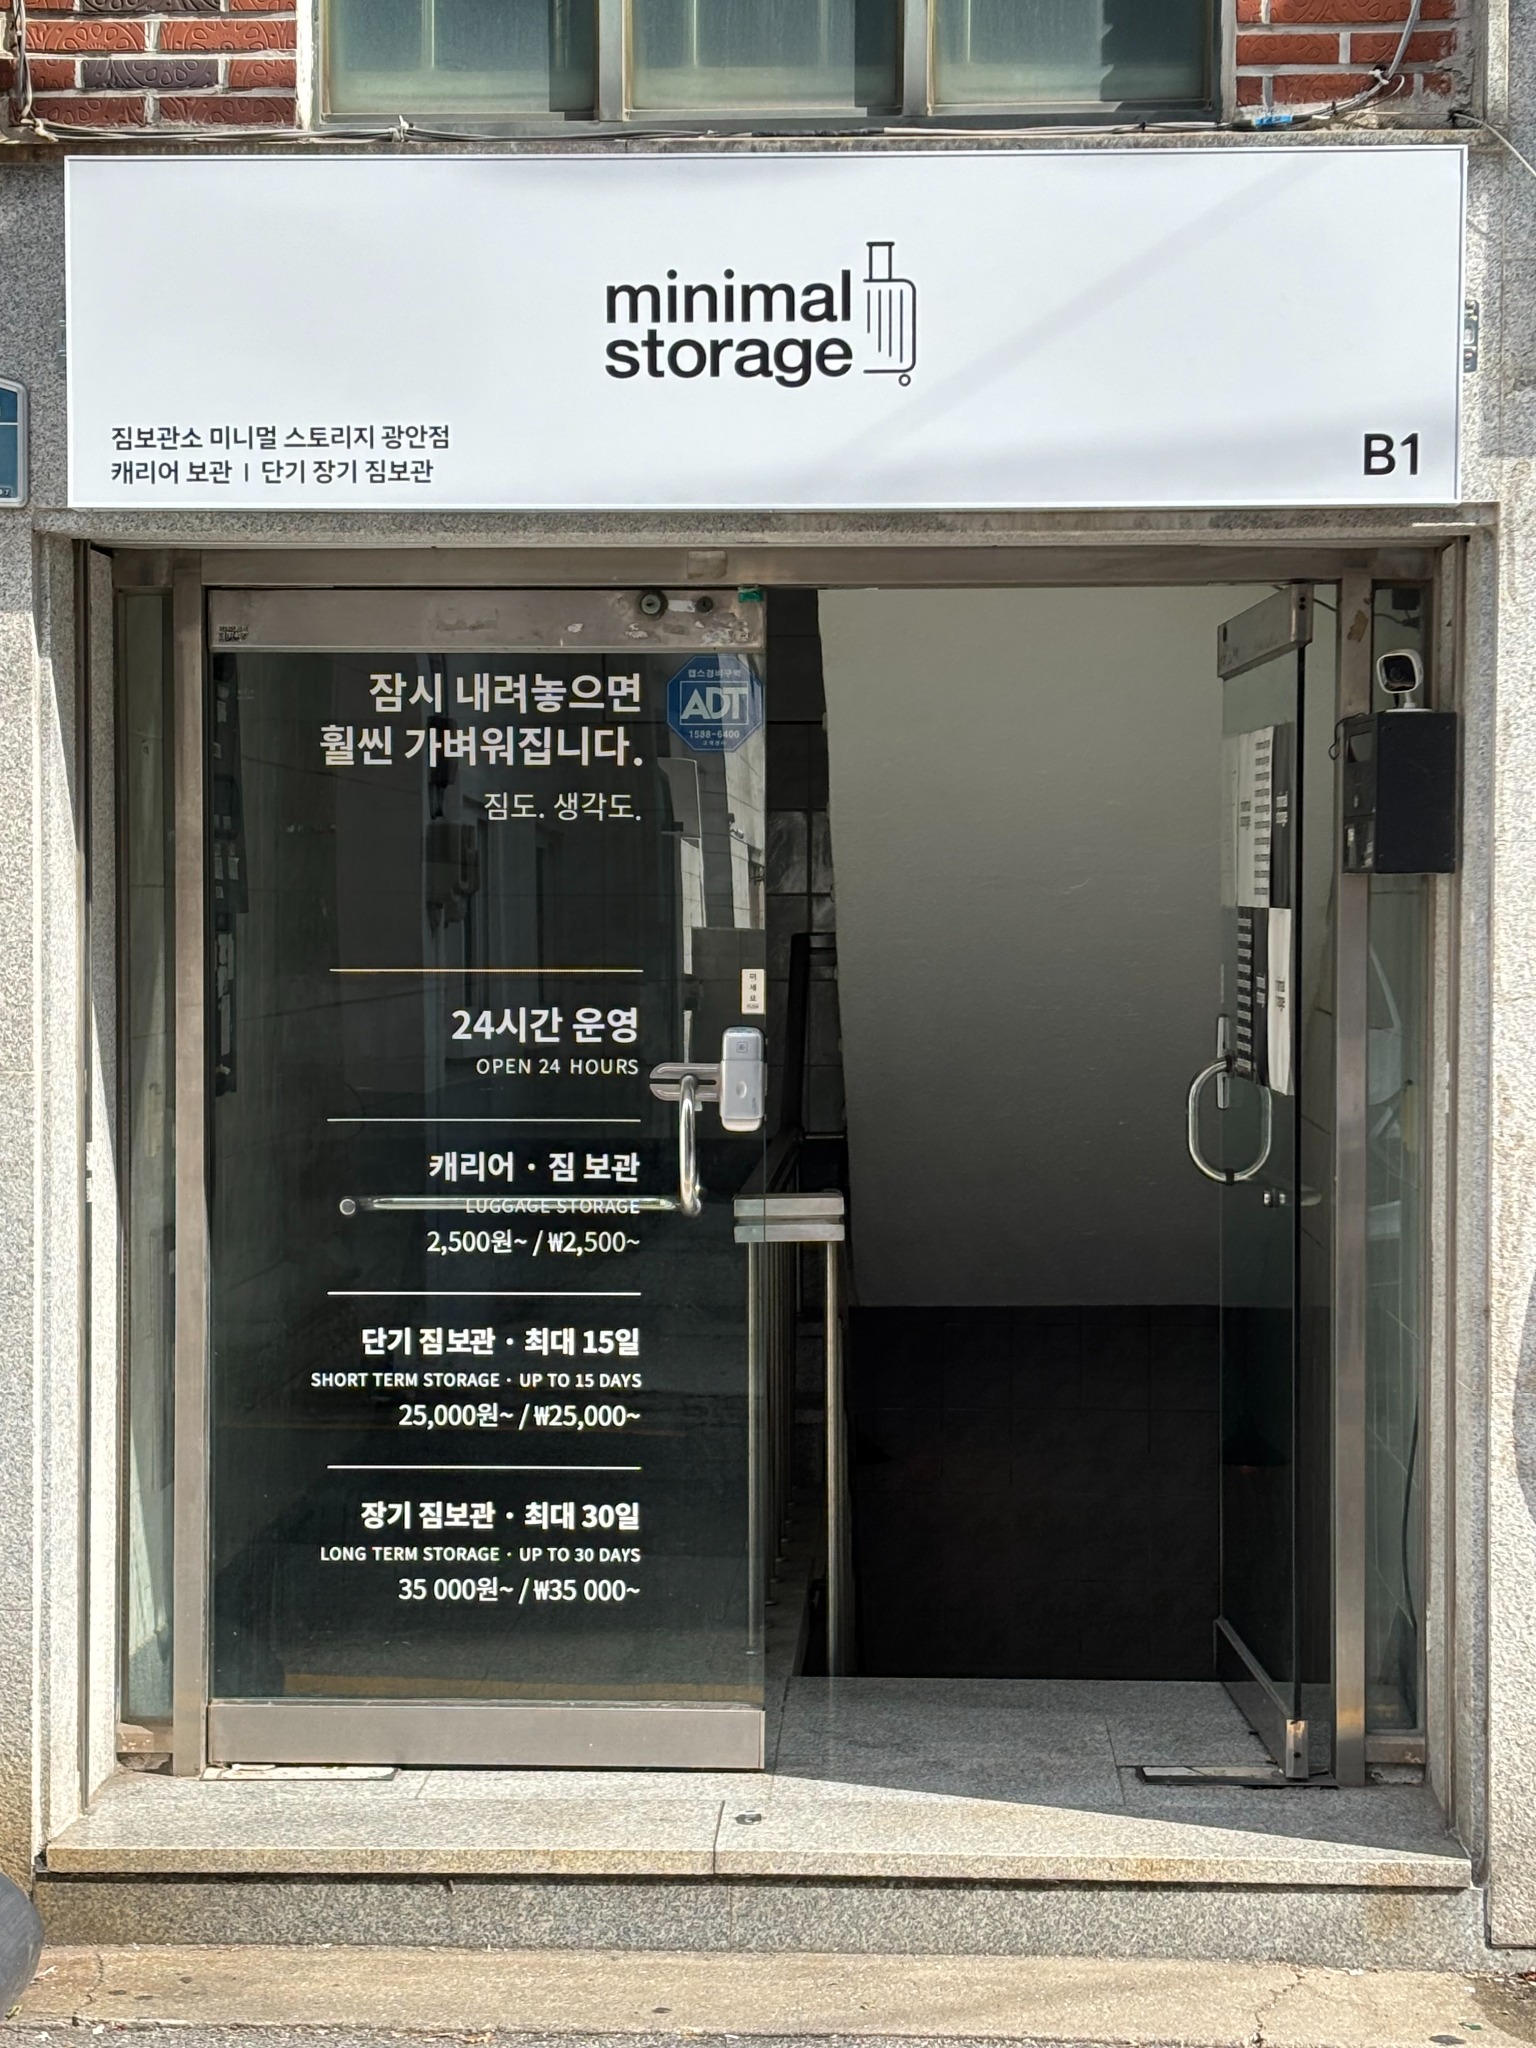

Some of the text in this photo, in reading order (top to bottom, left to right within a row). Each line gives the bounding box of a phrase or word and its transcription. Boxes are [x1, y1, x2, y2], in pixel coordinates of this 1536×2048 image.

[606, 268, 851, 324] minimal
[605, 328, 853, 388] storage
[112, 424, 449, 451] 짐보관소 미니멀 스토리지 광안점
[1363, 432, 1419, 476] B1
[111, 460, 179, 485] 캐리어
[186, 460, 233, 484] 보관
[262, 459, 305, 484] 단기
[313, 459, 357, 484] 장기
[365, 459, 434, 484] 짐보관
[369, 672, 641, 714] 잠시 내려놓으면
[681, 686, 749, 720] ADT
[319, 724, 643, 768] 훨씬 가벼워집니다.
[688, 729, 740, 739] 1588-6400
[484, 791, 642, 822] 짐도. 생각도.
[451, 1006, 638, 1044] 24시간 운영
[476, 1058, 639, 1075] OPEN 24 HOURS
[429, 1151, 515, 1183] 캐리어
[548, 1151, 575, 1182] 짐
[583, 1152, 641, 1183] 보관
[465, 1198, 641, 1215] LUGGAGE STORAGE
[426, 1228, 528, 1256] 2,500원~
[361, 1326, 412, 1356] 단기
[418, 1326, 497, 1356] 짐보관
[524, 1327, 575, 1357] 최대
[582, 1327, 640, 1357] 15일
[310, 1372, 369, 1388] SHORT
[371, 1372, 418, 1387] TERM
[423, 1372, 500, 1388] STORAGE
[519, 1372, 543, 1388] UP
[546, 1372, 571, 1388] TO
[575, 1373, 595, 1388] 15
[599, 1373, 643, 1389] DAYS
[398, 1402, 514, 1431] 25,000원~
[360, 1500, 411, 1530] 장기
[418, 1500, 496, 1530] 짐보관
[524, 1501, 575, 1531] 최대
[581, 1502, 640, 1531] 30일
[320, 1546, 367, 1562] LONG
[371, 1546, 418, 1562] TERM
[422, 1546, 500, 1562] STORAGE
[519, 1547, 543, 1562] UP
[546, 1547, 571, 1563] TO
[574, 1547, 595, 1563] 30
[599, 1547, 642, 1563] DAYS
